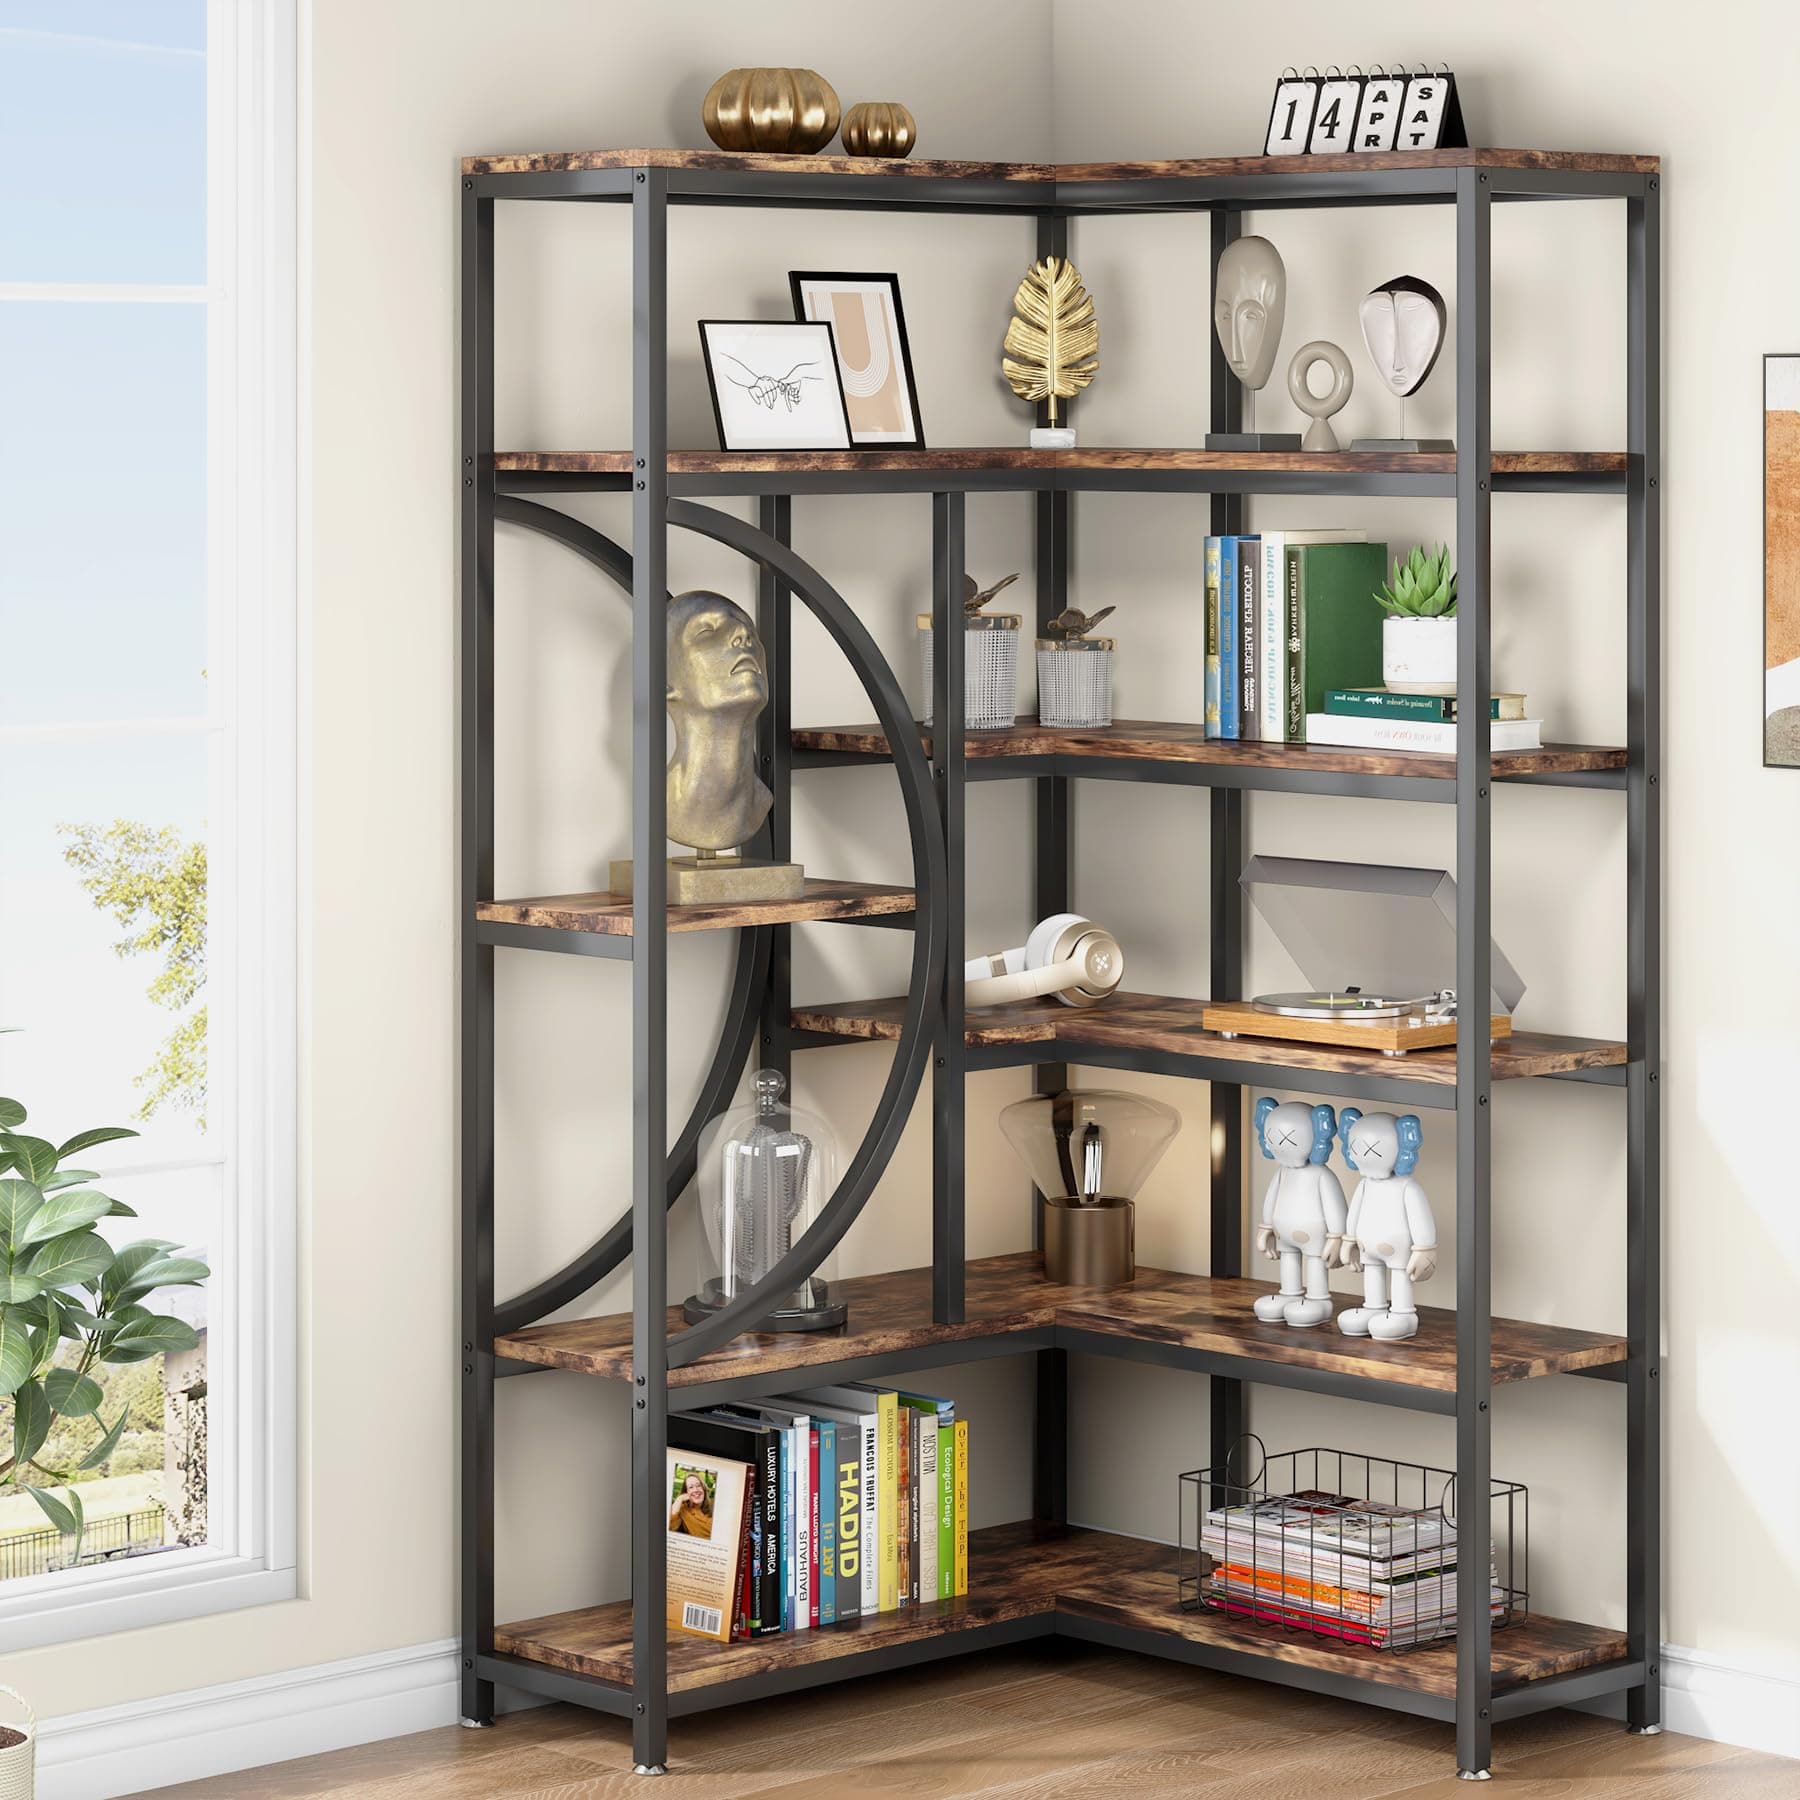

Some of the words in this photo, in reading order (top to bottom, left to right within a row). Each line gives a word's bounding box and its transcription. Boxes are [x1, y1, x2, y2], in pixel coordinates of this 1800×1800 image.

[1280, 97, 1342, 140] 14
[1364, 90, 1389, 147] APR
[1409, 87, 1433, 146] SAT
[886, 1408, 894, 1444] BLOSSOM
[767, 1446, 776, 1486] LUXURY
[865, 1427, 875, 1471] FRANCOIS
[922, 1434, 936, 1475] WILLSON
[958, 1429, 966, 1469] Over
[942, 1447, 953, 1493] Ecological
[767, 1486, 776, 1522] HOTELS
[865, 1474, 875, 1512] TRUFFAT
[942, 1495, 952, 1528] Design
[839, 1461, 859, 1578] HADID
[865, 1516, 873, 1530] The
[923, 1503, 936, 1521] LAID
[767, 1533, 776, 1576] AMERICA
[864, 1531, 873, 1568] Complete
[923, 1528, 936, 1551] HAVE
[799, 1530, 808, 1602] BAUHAUS
[822, 1545, 834, 1577] ART
[865, 1569, 873, 1590] Films
[923, 1565, 936, 1590] EGGS
